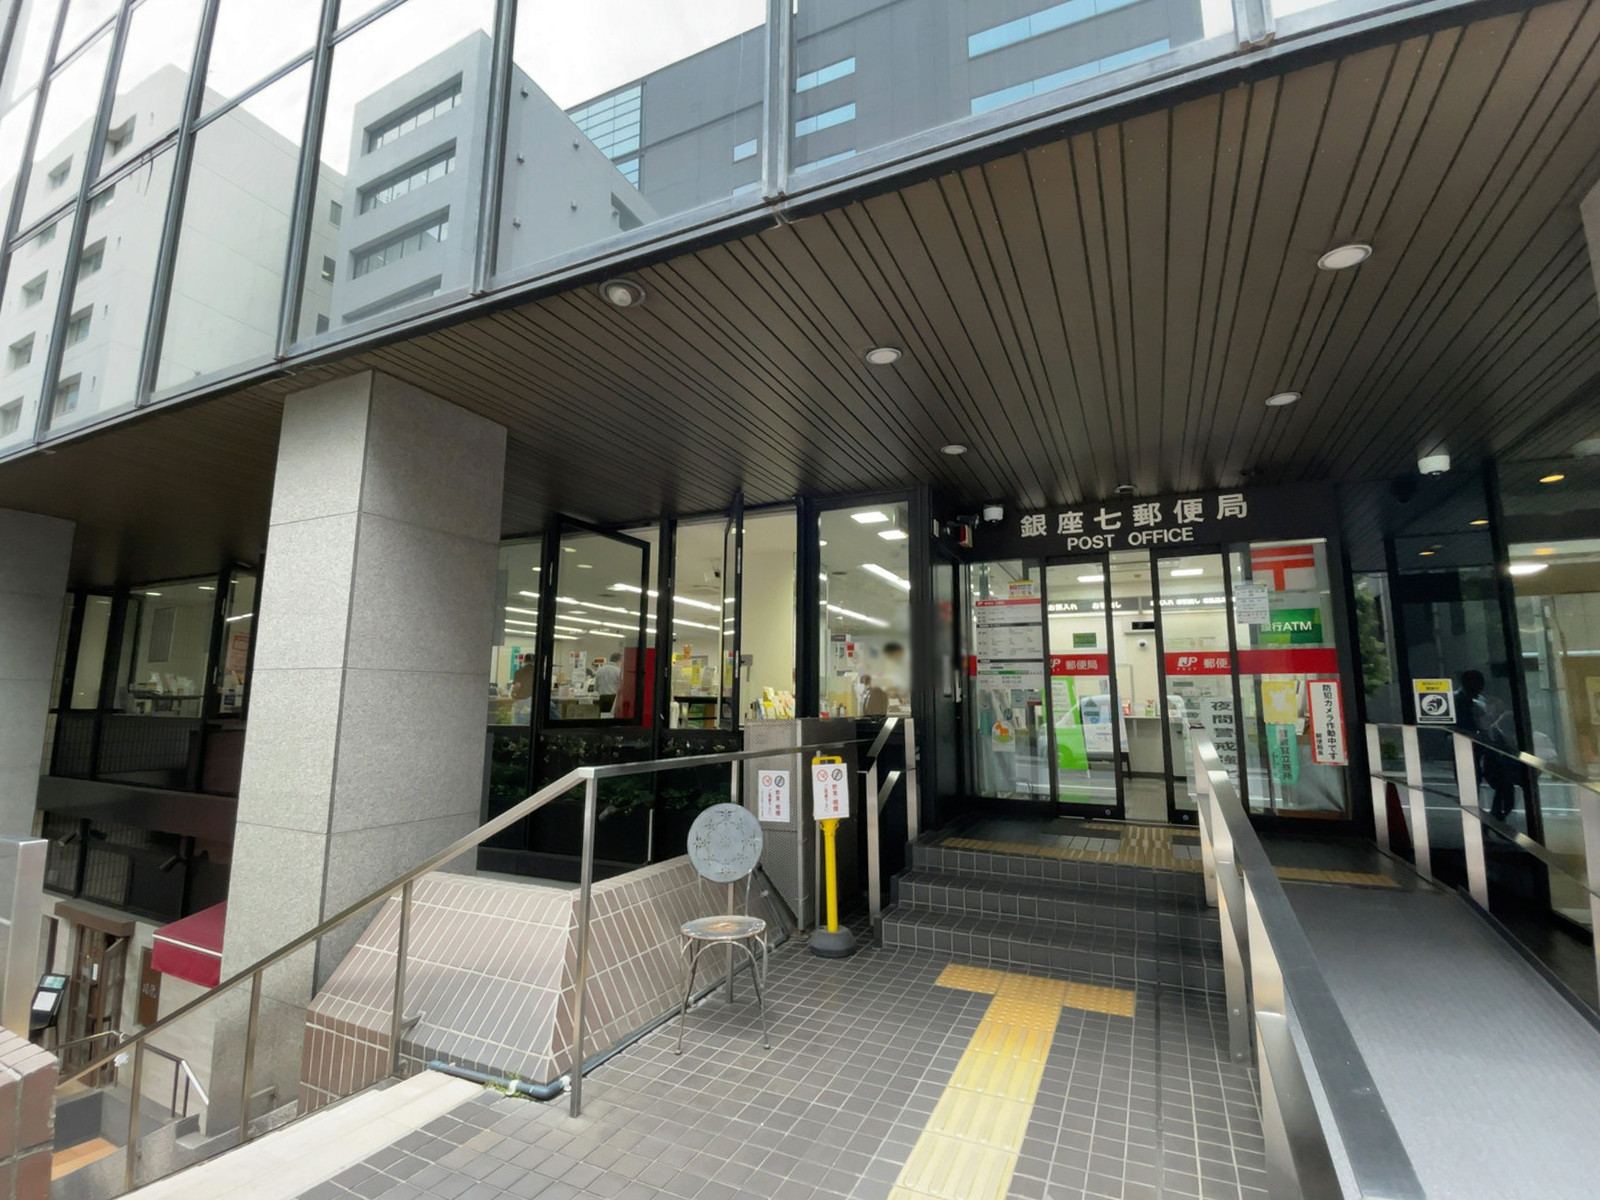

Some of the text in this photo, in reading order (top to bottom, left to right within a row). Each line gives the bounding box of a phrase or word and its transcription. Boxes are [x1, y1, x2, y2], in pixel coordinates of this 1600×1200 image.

[1020, 493, 1248, 538] 銀座七郵便局
[1067, 527, 1194, 551] POST OFFICE
[1065, 659, 1098, 670] 郵便局
[1203, 657, 1231, 669] 郵便
[1322, 684, 1338, 761] 防犯カメラ作動中です
